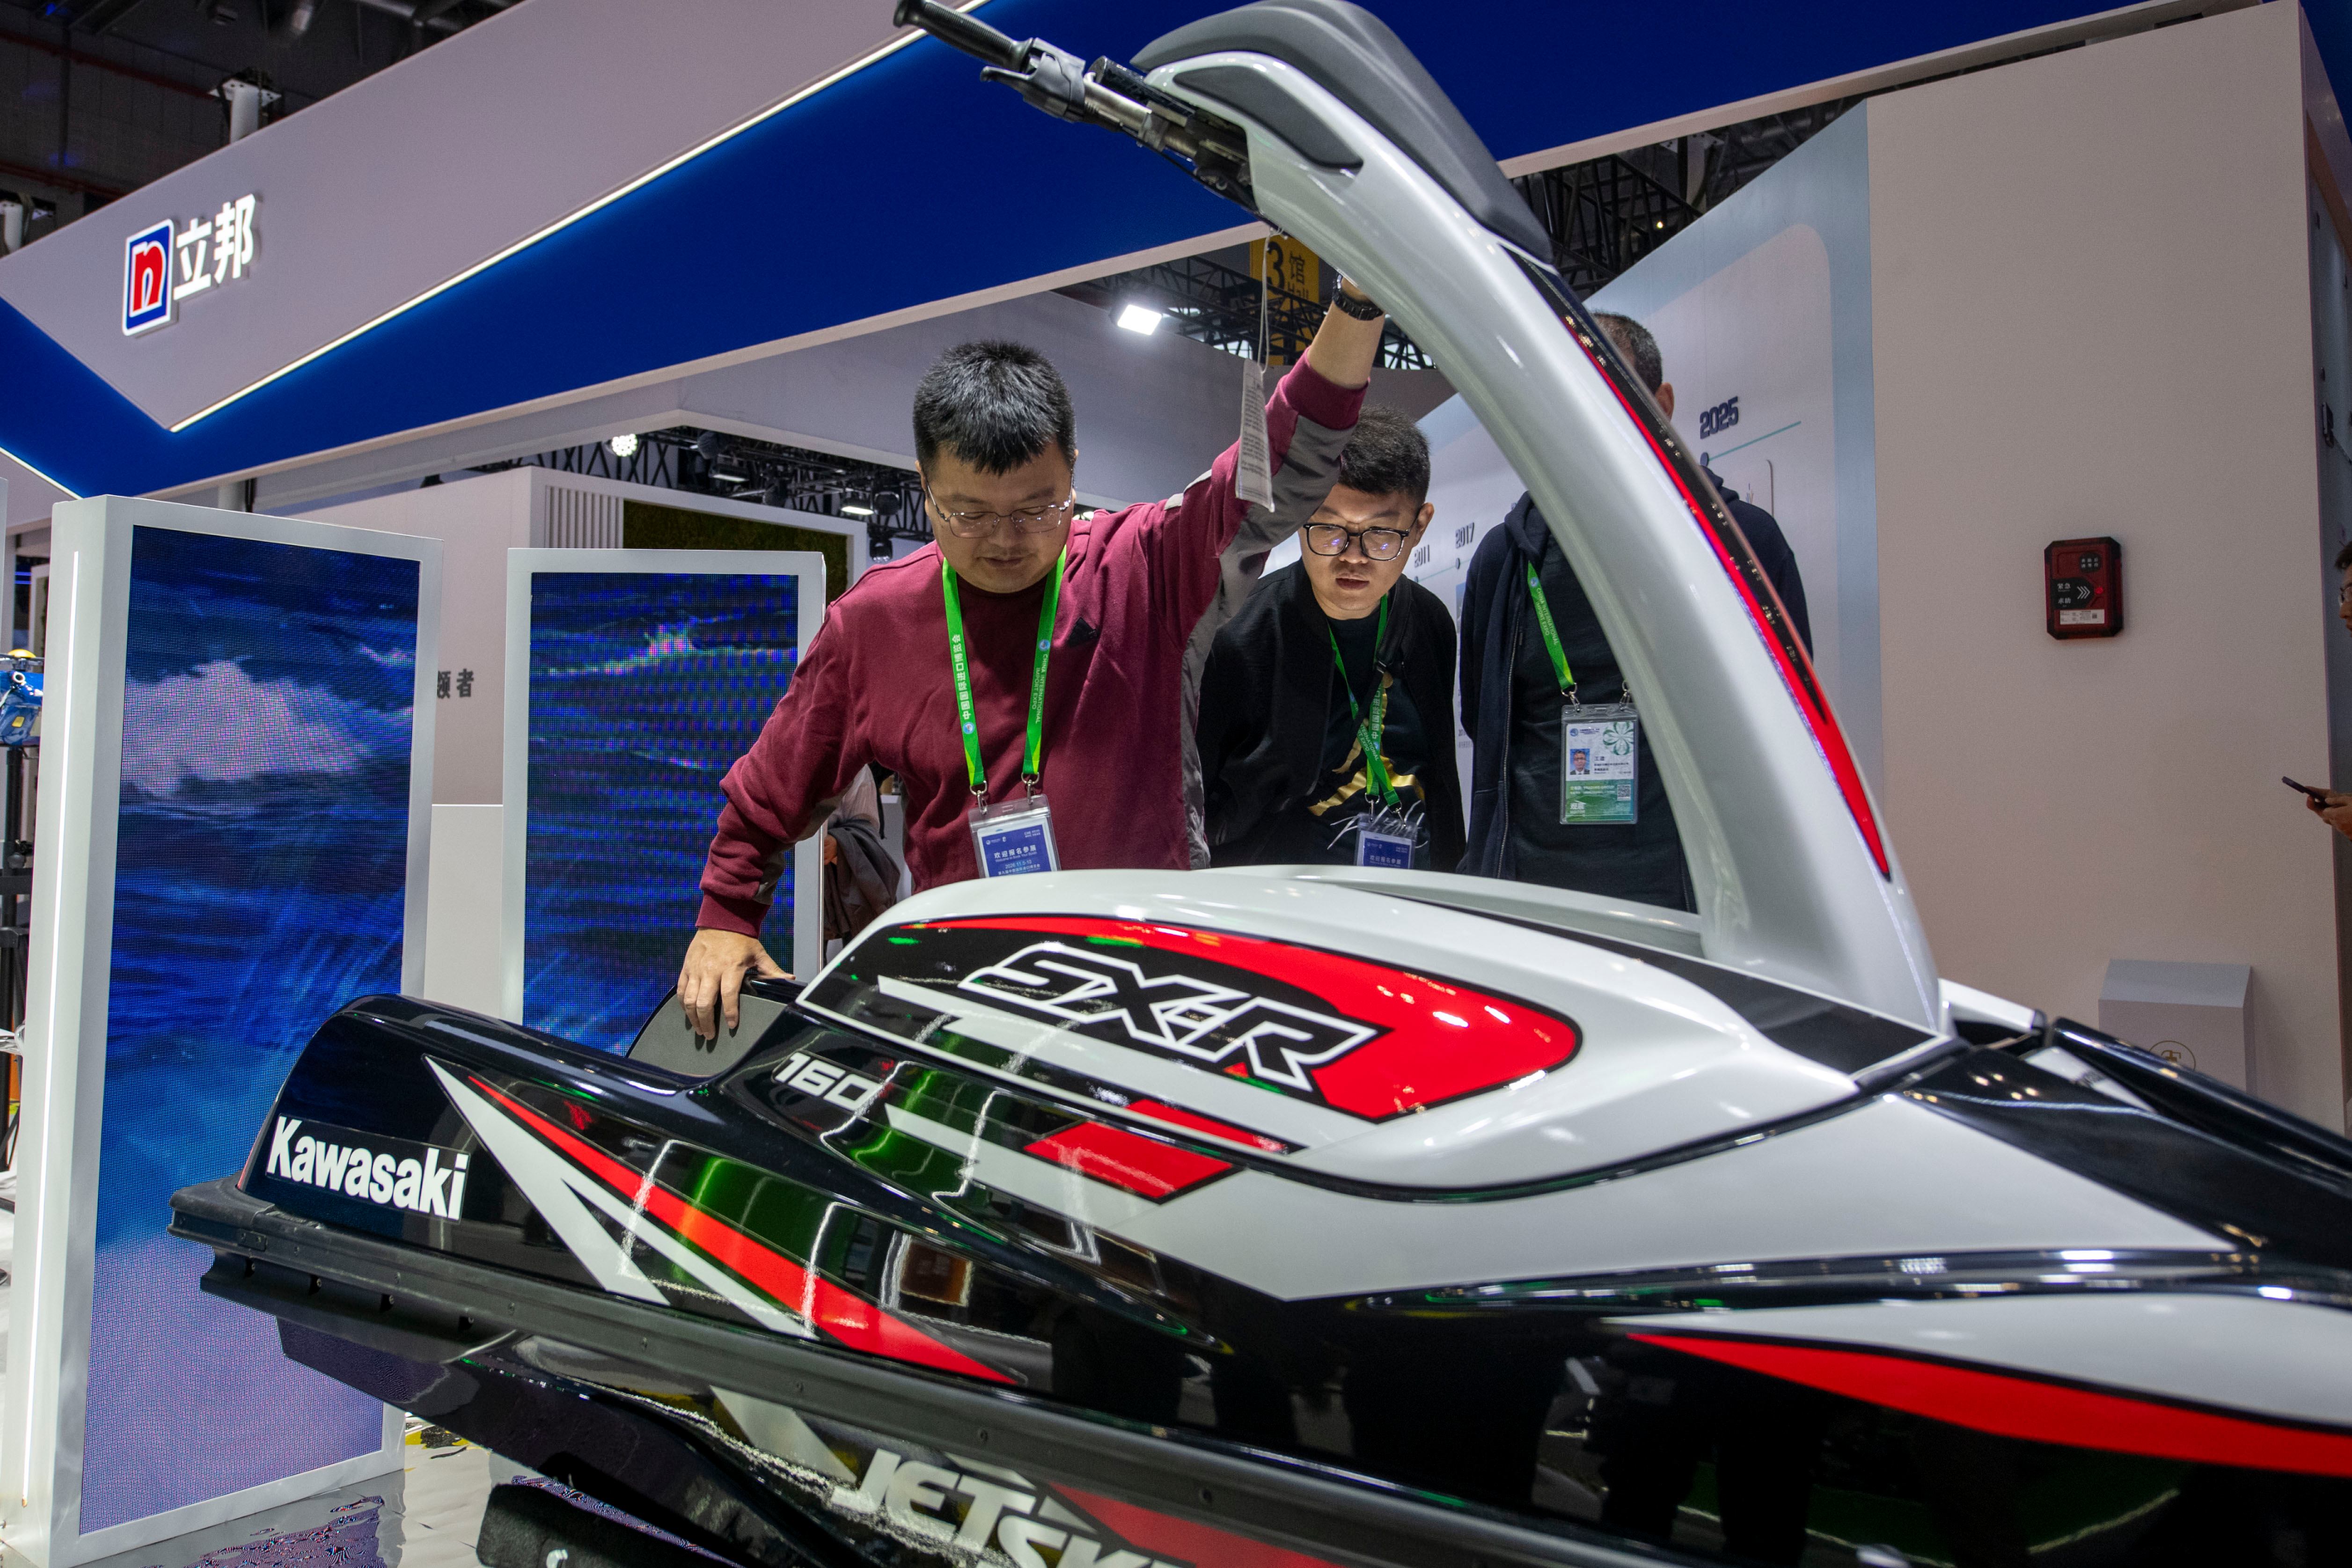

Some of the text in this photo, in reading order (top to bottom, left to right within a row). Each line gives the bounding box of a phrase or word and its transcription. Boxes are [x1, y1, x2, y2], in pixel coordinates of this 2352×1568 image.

[174, 194, 256, 300] 立邦
[1700, 396, 1739, 439] 2025
[1414, 544, 1430, 568] 2011
[1455, 522, 1474, 549] 2017
[952, 634, 971, 720] 中国国际进口博览会
[1035, 674, 1045, 724] INTERNATIONAL
[1371, 685, 1381, 739] 中国国际进口
[1360, 737, 1370, 751] EXPO
[1361, 725, 1379, 761] TERNATIONAL
[994, 844, 1037, 858] 欢迎报名参展
[775, 1052, 883, 1112] 160
[266, 1116, 469, 1221] Kawasaki
[832, 1448, 1180, 1568] JETS
